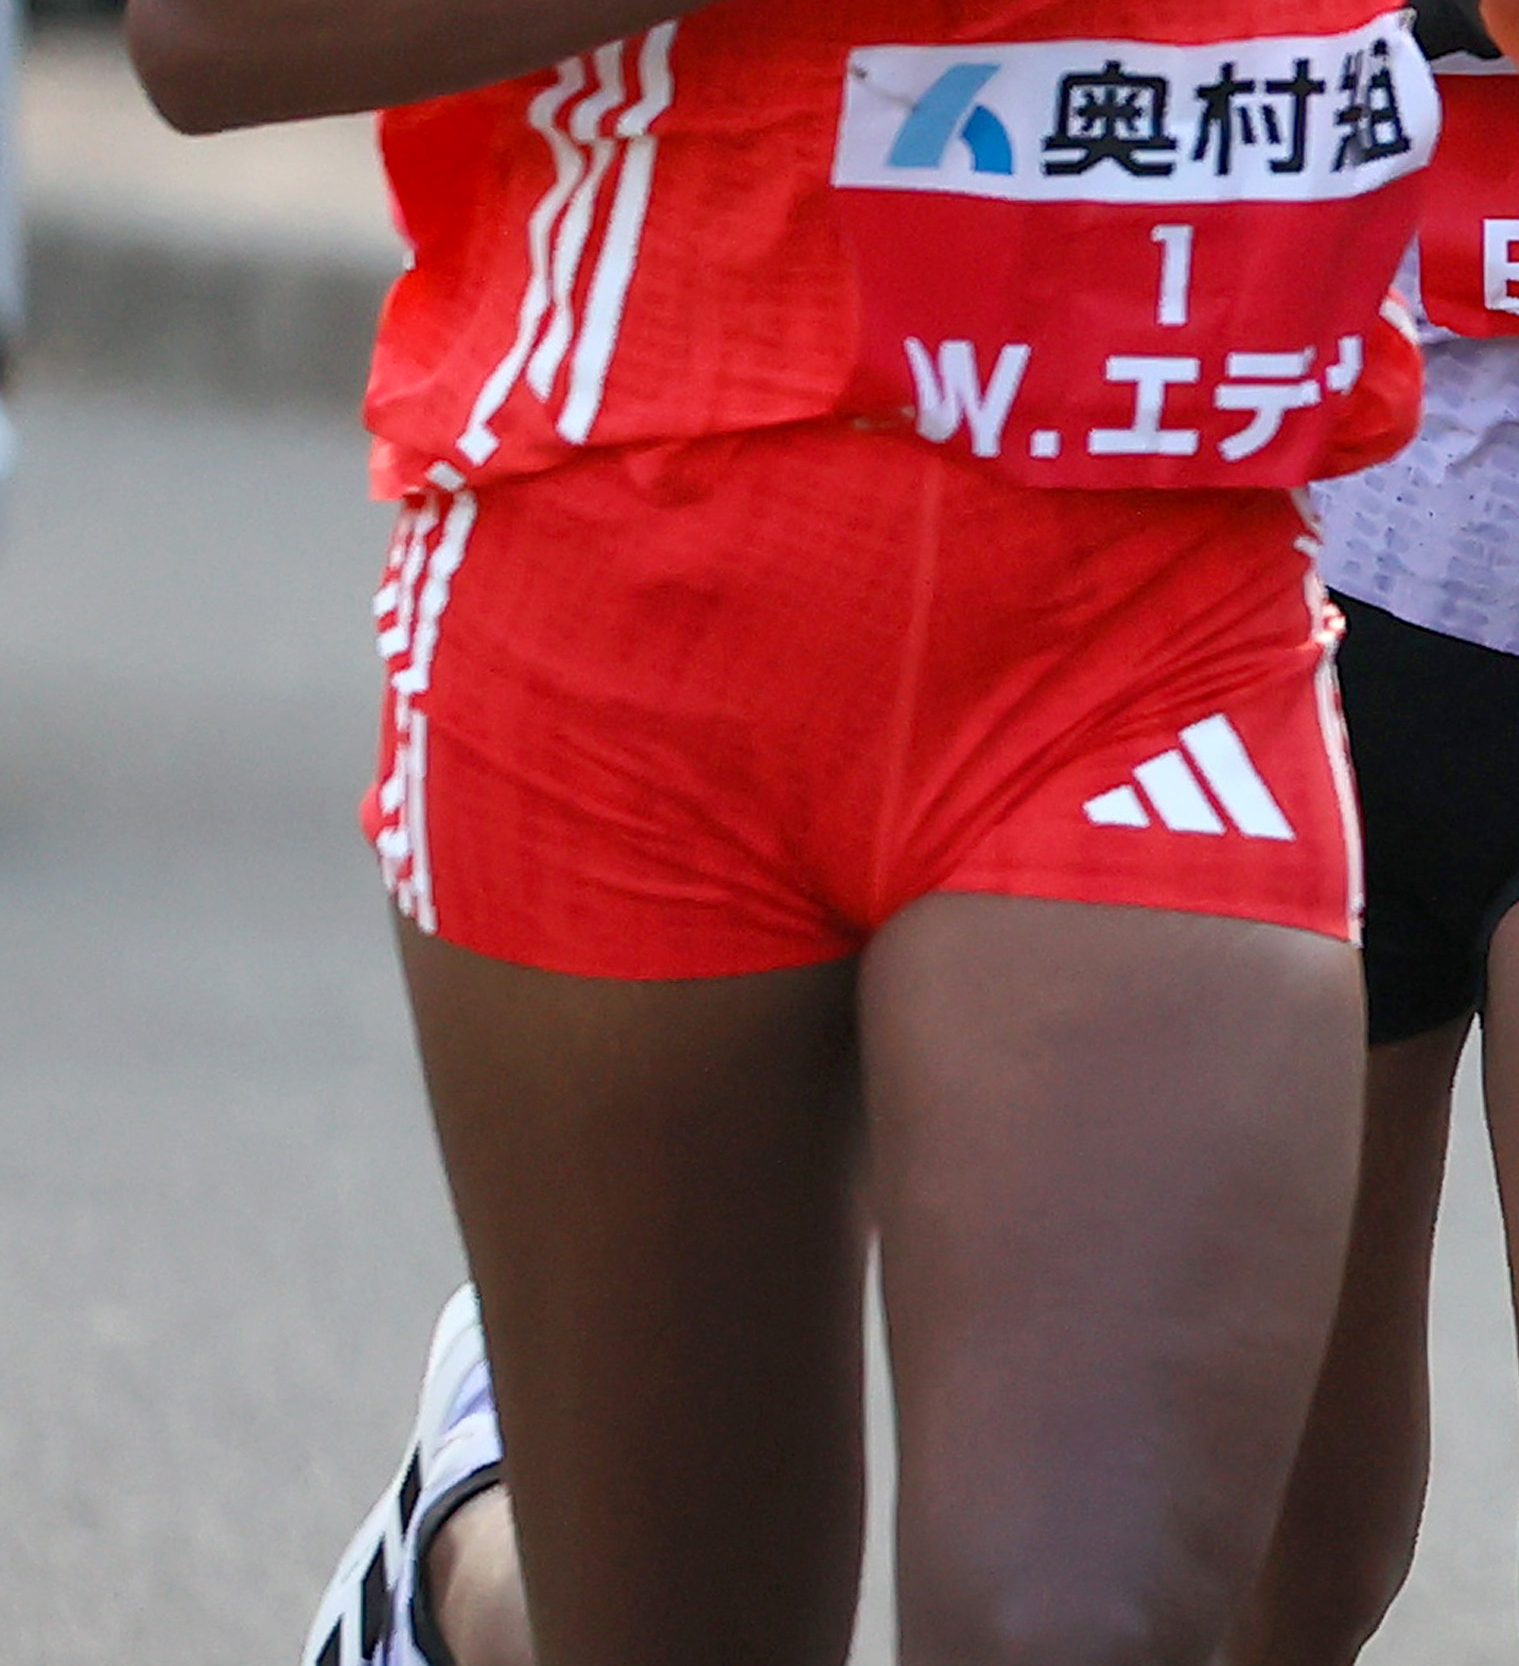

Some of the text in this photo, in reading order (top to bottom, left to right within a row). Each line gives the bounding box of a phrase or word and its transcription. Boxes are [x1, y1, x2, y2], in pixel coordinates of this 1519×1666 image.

[1040, 37, 1411, 177] 奥村組
[1149, 223, 1194, 328] 1
